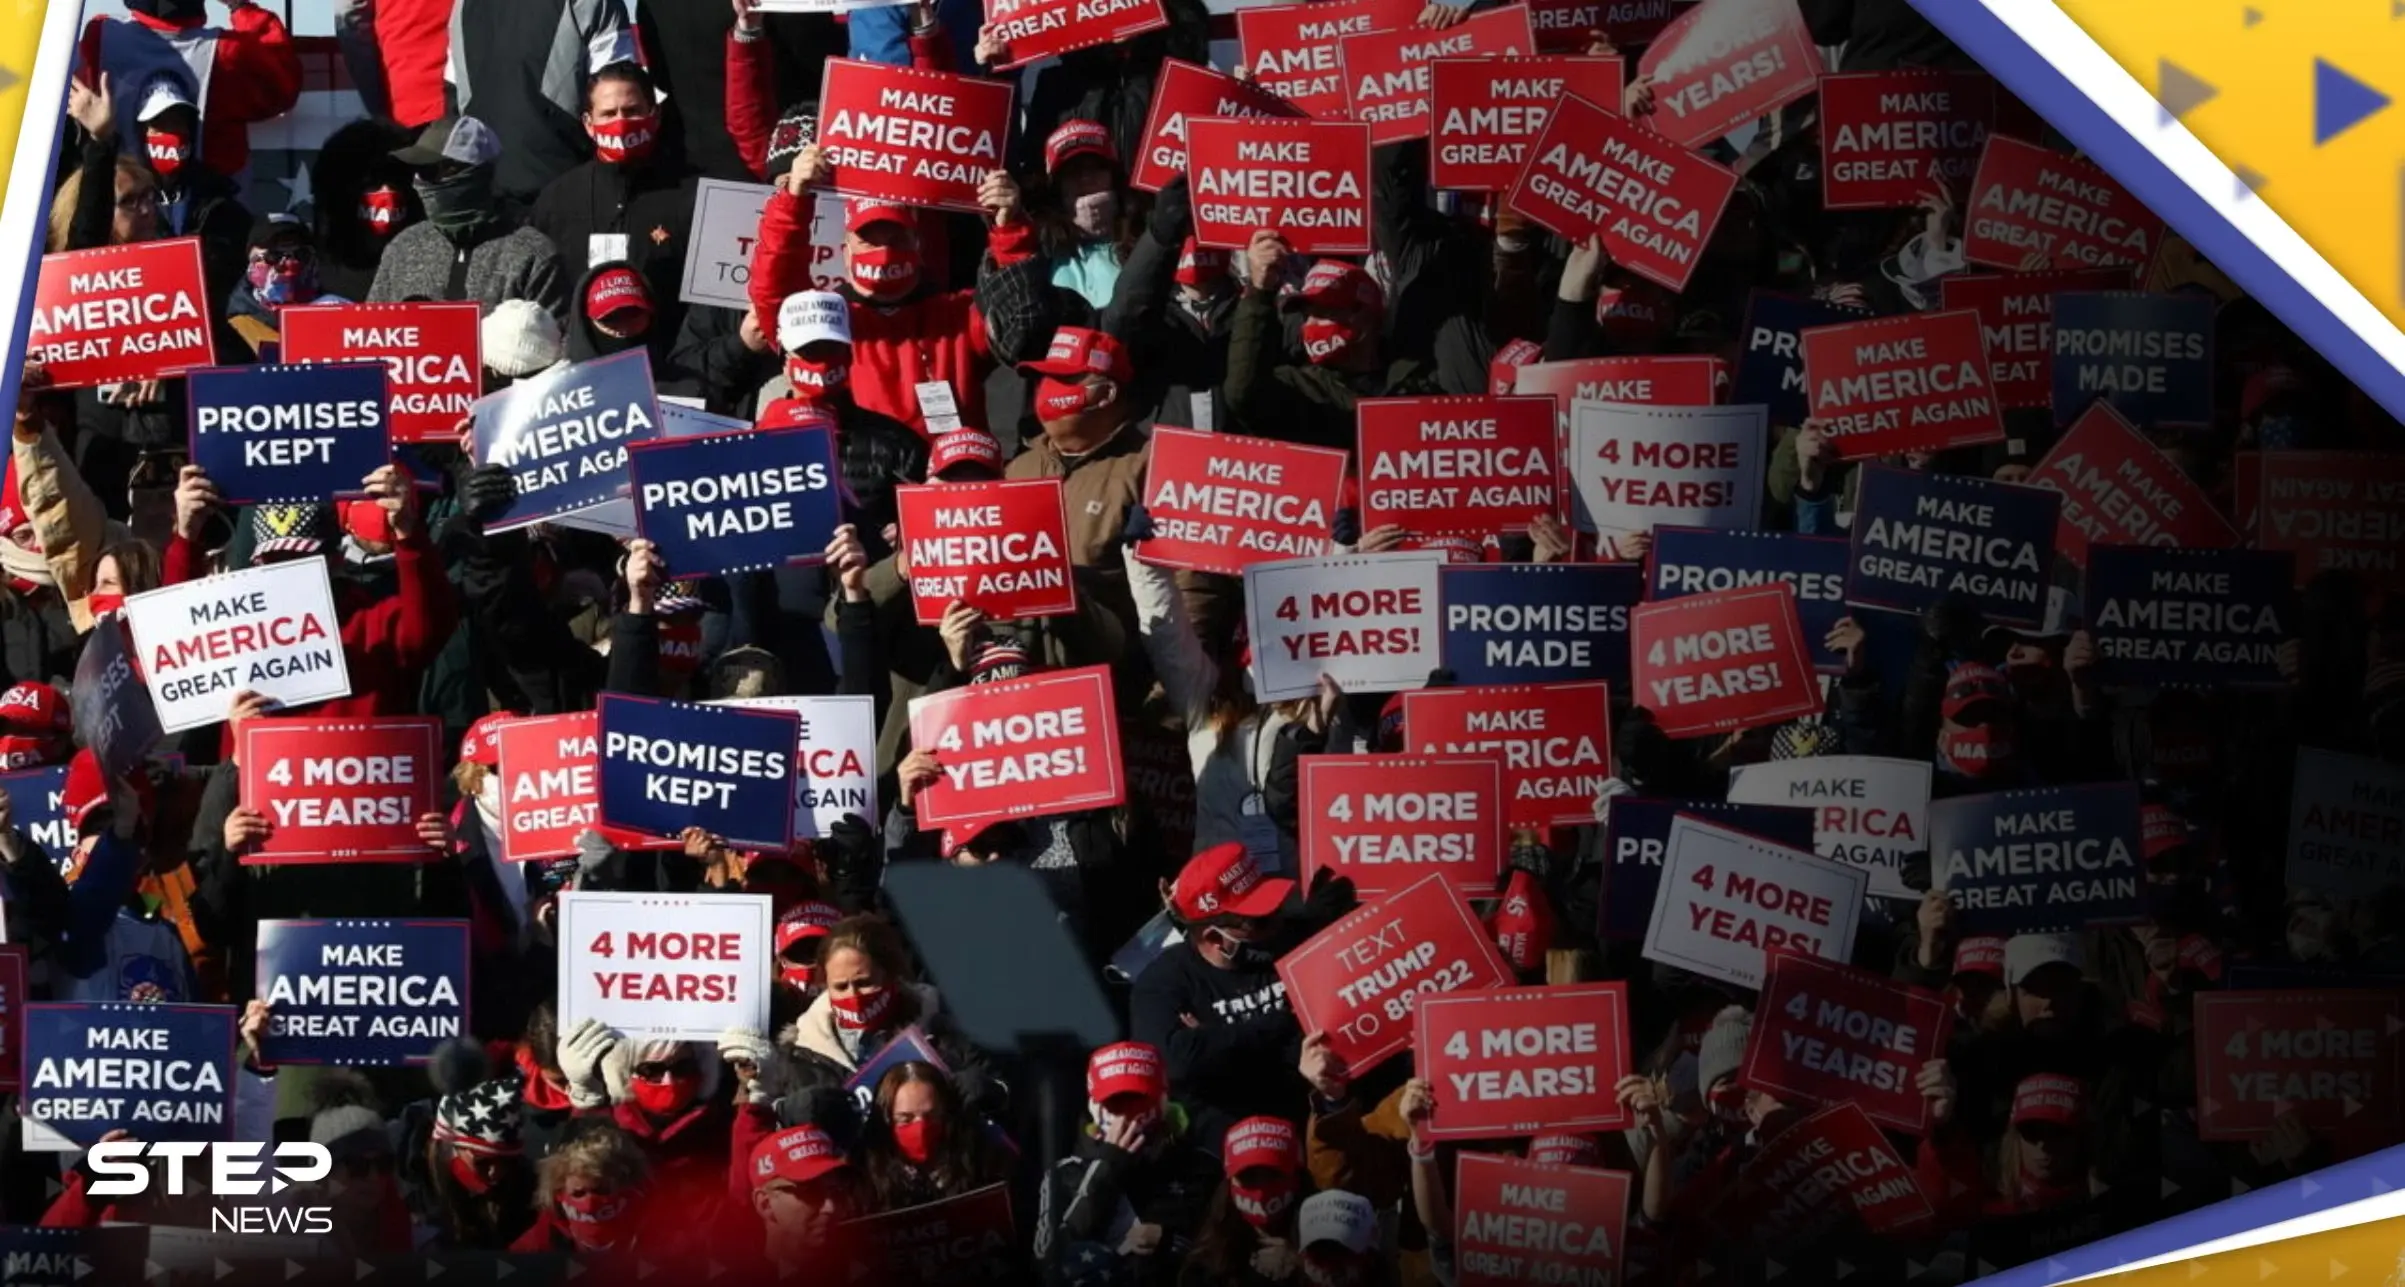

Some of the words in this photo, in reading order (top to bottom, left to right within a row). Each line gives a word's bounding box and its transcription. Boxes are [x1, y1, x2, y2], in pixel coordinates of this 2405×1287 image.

[990, 8, 1067, 43] GREAT
[1299, 16, 1371, 40] MAKE
[1529, 8, 1600, 28] GREAT
[1606, 3, 1668, 22] AGAIN
[1400, 35, 1473, 62] MAKE
[1260, 76, 1340, 99] GREAT
[1490, 79, 1564, 99] MAKE
[1664, 44, 1786, 118] YEARS!
[880, 87, 954, 116] MAKE
[1360, 99, 1430, 122] GREA
[1880, 92, 1951, 113] MAKE
[593, 128, 652, 150] MAGA
[828, 110, 996, 158] AMERICA
[826, 146, 909, 175] GREAT
[1239, 142, 1310, 162] MAKE
[1441, 144, 1527, 164] GREAT
[1602, 138, 1675, 185] MAKE
[1198, 167, 1361, 199] AMERICA
[1833, 160, 1919, 181] GREAT
[1541, 143, 1700, 238] AMERICA
[2037, 168, 2112, 207] MAKE
[1199, 202, 1271, 223] GREAT
[1279, 207, 1362, 228] AGAIN
[1529, 174, 1612, 223] GREAT
[1610, 217, 1691, 264] AGAIN
[1979, 183, 2148, 255] AMERICA
[1974, 218, 2056, 252] GREAT
[70, 268, 144, 293] MAKE
[716, 262, 751, 284] TO
[856, 260, 914, 281] MAGA
[30, 291, 198, 335] AMERICA
[32, 338, 110, 365] GREAT
[121, 327, 201, 353] AGAIN
[343, 327, 419, 347] MAKE
[1856, 337, 1928, 366] MAKE
[2055, 328, 2204, 360] PROMISES
[792, 366, 845, 388] MAGA
[1576, 380, 1652, 400] MAKE
[1817, 361, 1984, 409] AMERICA
[2079, 364, 2167, 393] MADE
[198, 401, 381, 434] PROMISES
[390, 393, 472, 414] AGAIN
[1820, 408, 1901, 438] GREAT
[1910, 398, 1991, 426] AGAIN
[1420, 419, 1497, 441] MAKE
[245, 438, 336, 467] KEPT
[1369, 448, 1551, 481] AMERICA
[1597, 438, 1620, 465] 4
[1633, 441, 1739, 469] MORE
[643, 462, 828, 511] PROMISES
[1207, 457, 1283, 485] MAKE
[1154, 480, 1327, 529] AMERICA
[1370, 488, 1459, 511] GREAT
[1467, 485, 1553, 507] AGAIN
[1600, 476, 1735, 509] YEARS!
[2116, 458, 2184, 520] MAKE
[687, 503, 795, 540] MADE
[935, 506, 1002, 529] MAKE
[1917, 496, 1995, 527] MAKE
[911, 530, 1060, 568] AMERICA
[1152, 517, 1235, 544] GREAT
[1239, 531, 1324, 558] AGAIN
[1862, 518, 2040, 574] AMERICA
[914, 575, 968, 597] GREAT
[977, 567, 1064, 593] AGAIN
[1859, 555, 1944, 588] GREAT
[1948, 569, 2038, 603] AGAIN
[2152, 571, 2230, 595] MAKE
[190, 593, 267, 626] MAKE
[1276, 596, 1299, 622] 4
[1312, 587, 1423, 618] MORE
[1448, 603, 1628, 632] PROMISES
[2096, 597, 2284, 634] AMERICA
[153, 613, 328, 674] AMERICA
[1281, 627, 1420, 661] YEARS!
[1486, 640, 1592, 667] MADE
[1647, 640, 1667, 667] 4
[1673, 624, 1775, 667] MORE
[2097, 637, 2187, 661] GREAT
[161, 666, 239, 703] GREAT
[248, 649, 334, 684] AGAIN
[1651, 662, 1783, 706] YEARS!
[938, 725, 963, 752] 4
[973, 706, 1087, 749] MORE
[1467, 708, 1546, 732] MAKE
[266, 758, 292, 785] 4
[303, 756, 414, 785] MORE
[606, 731, 786, 780] PROMISES
[944, 745, 1087, 791] YEARS!
[646, 773, 737, 810] KEPT
[1515, 776, 1602, 799] AGAIN
[1789, 778, 1867, 799] MAKE
[271, 796, 412, 827] YEARS!
[513, 802, 599, 833] GREAT
[1327, 795, 1353, 822] 4
[1364, 792, 1479, 822] MORE
[1994, 810, 2076, 838] MAKE
[1331, 832, 1475, 864] YEARS!
[1945, 836, 2135, 879] AMERICA
[1690, 863, 1714, 892] 4
[1724, 872, 1833, 927] MORE
[1948, 883, 2038, 911] GREAT
[2046, 876, 2137, 905] AGAIN
[1688, 901, 1823, 955] YEARS!
[321, 944, 404, 967] MAKE
[589, 931, 614, 959] 4
[627, 932, 741, 961] MORE
[1335, 917, 1409, 972] TEXT
[266, 975, 460, 1006] AMERICA
[592, 972, 738, 1002] YEARS!
[1337, 944, 1437, 1009] TRUMP
[1212, 981, 1286, 1016] TRUMP
[267, 1015, 361, 1037] GREAT
[367, 1016, 461, 1038] AGAIN
[1338, 1012, 1380, 1044] TO
[1784, 990, 1809, 1020] 4
[1815, 999, 1919, 1055] MORE
[87, 1027, 170, 1051] MAKE
[1443, 1031, 1469, 1060] 4
[1482, 1024, 1598, 1060] MORE
[2223, 1030, 2250, 1059] 4
[2261, 1028, 2378, 1060] MORE
[32, 1057, 225, 1093] AMERICA
[1781, 1030, 1907, 1095] YEARS!
[1448, 1066, 1596, 1102] YEARS!
[2229, 1069, 2374, 1102] YEARS!
[31, 1098, 125, 1120] GREAT
[131, 1100, 224, 1124] AGAIN
[1501, 1182, 1567, 1211] MAKE
[1462, 1209, 1613, 1258] AMERICA
[1462, 1251, 1525, 1280] GREAT
